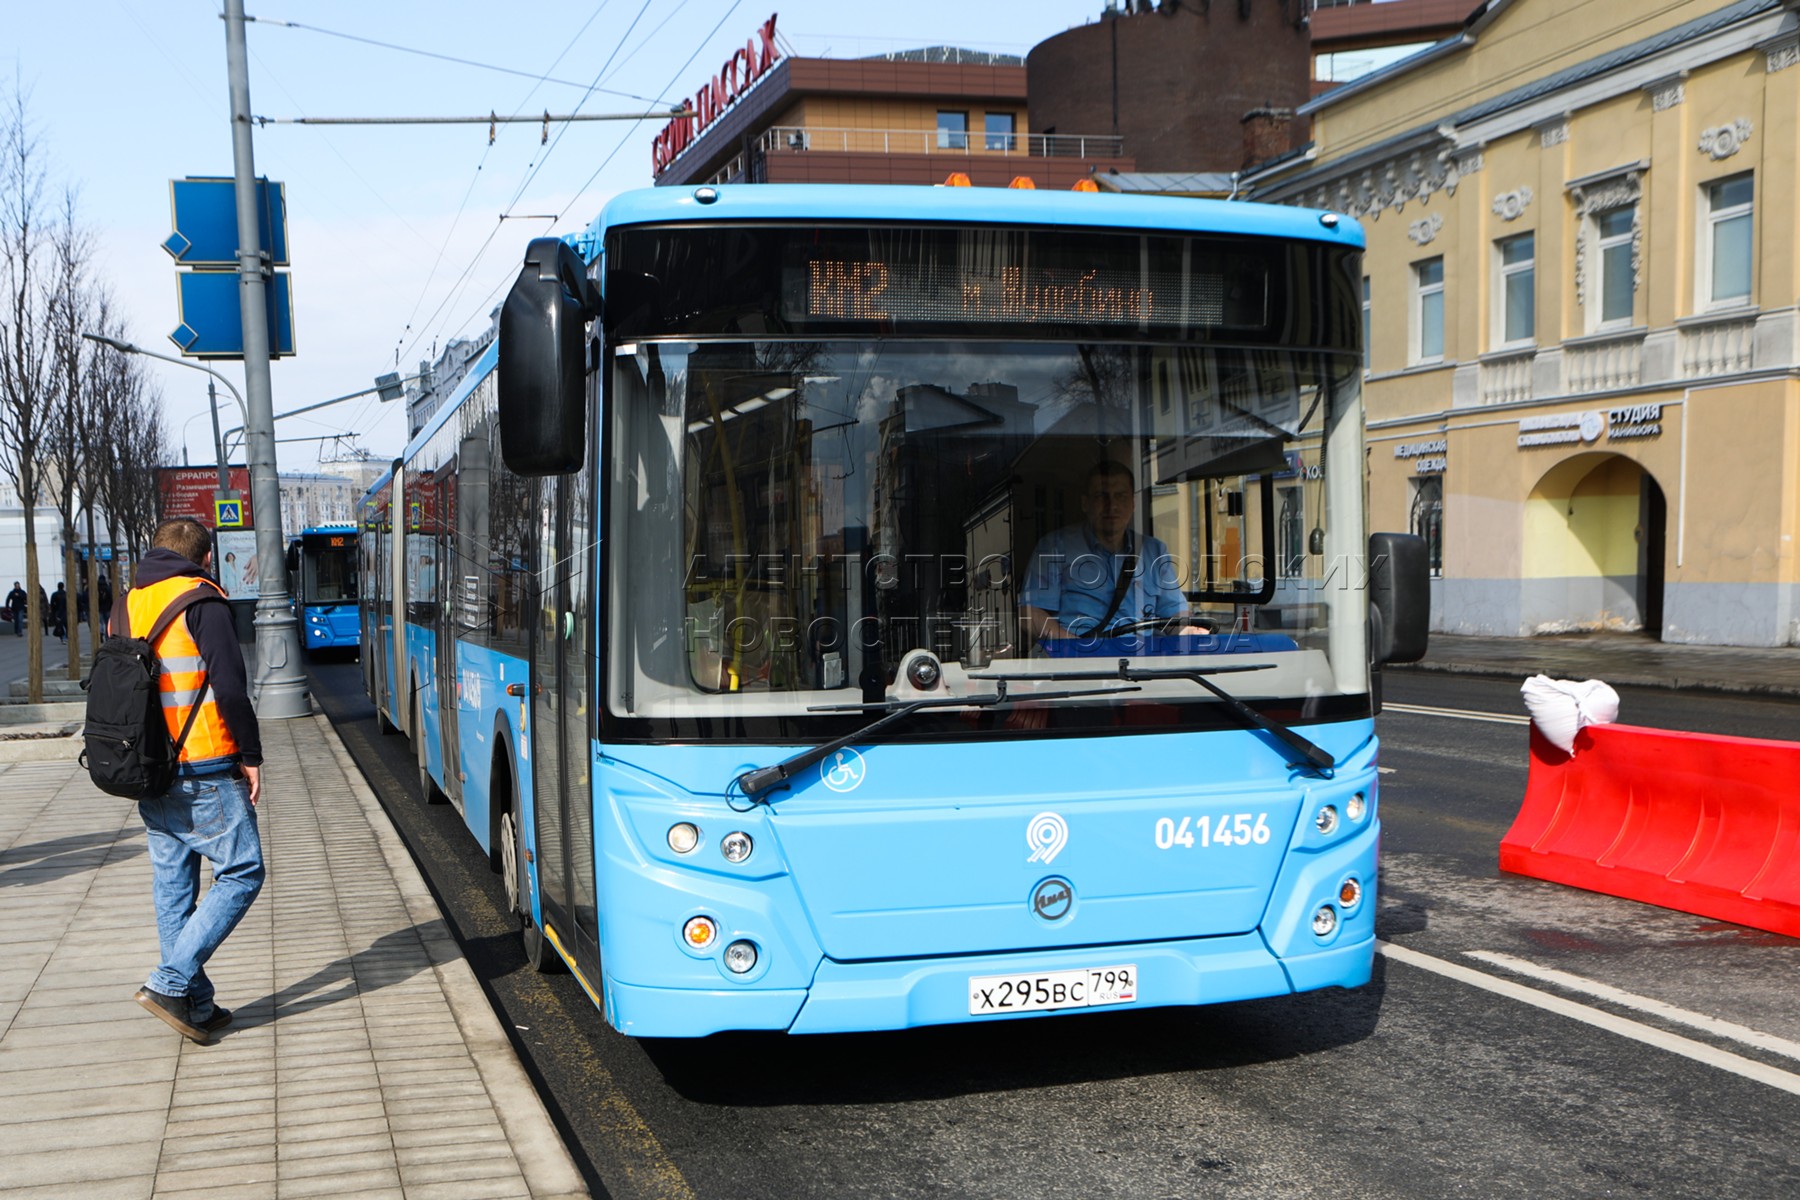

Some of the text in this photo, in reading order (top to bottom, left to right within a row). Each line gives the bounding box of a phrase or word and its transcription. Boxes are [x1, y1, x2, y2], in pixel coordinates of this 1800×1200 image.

[696, 13, 781, 134] ПАССАЖ
[809, 260, 888, 319] КМ2
[1608, 404, 1662, 425] СТУДИЯ
[1608, 424, 1662, 440] МАНИКЮРА
[1394, 440, 1447, 459] МЕДИЦИНСКАЯ
[1416, 458, 1447, 473] ОДЕЖДА
[1155, 812, 1271, 850] 041456
[1091, 970, 1130, 993] 799
[1100, 991, 1119, 1001] RUS
